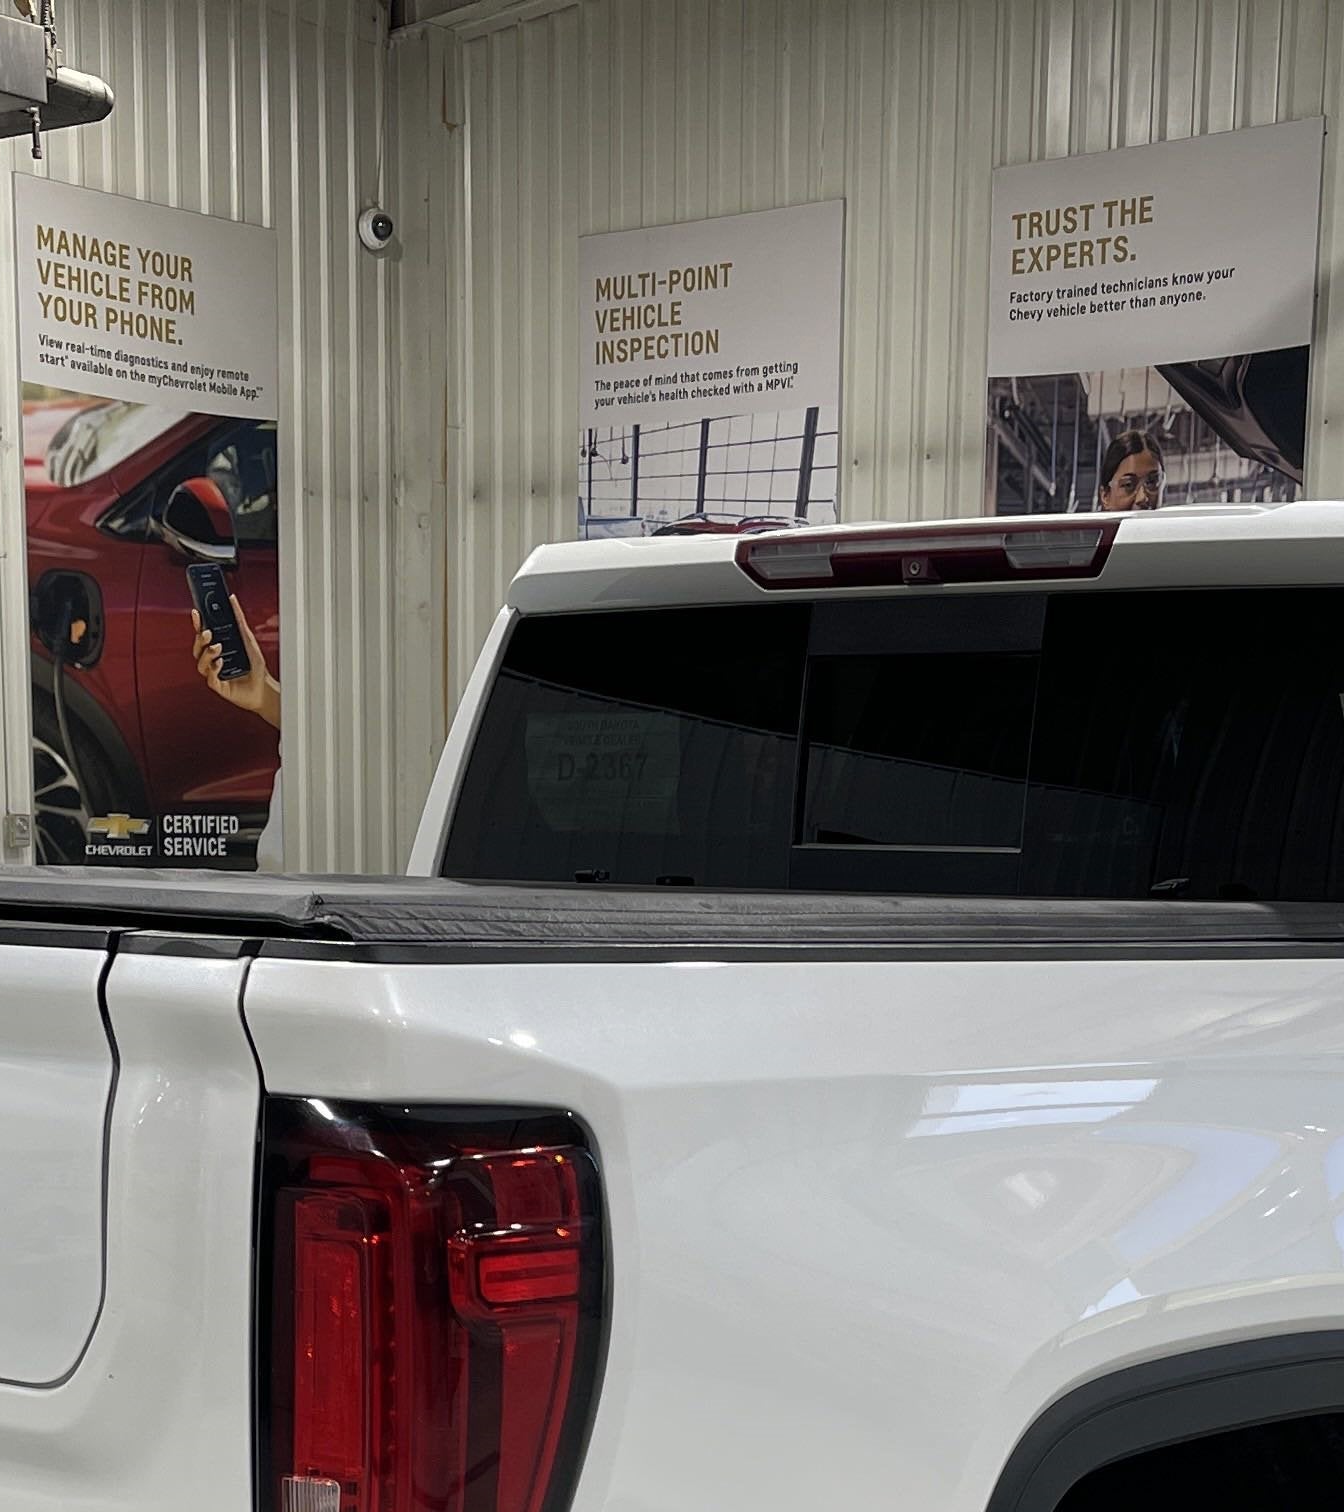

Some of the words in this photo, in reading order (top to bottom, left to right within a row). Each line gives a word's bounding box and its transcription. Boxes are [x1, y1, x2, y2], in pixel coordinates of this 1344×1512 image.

[1011, 203, 1095, 241] TRUST
[1103, 195, 1154, 229] THE
[36, 224, 130, 270] MANAGE
[137, 247, 193, 283] YOUR
[1011, 235, 1137, 275] EXPERTS.
[37, 258, 131, 304] VEHICLE
[137, 280, 195, 316] FROM
[595, 262, 733, 302] MULTI-POINT
[1009, 288, 1053, 304] Factory
[1056, 282, 1098, 300] trained
[1100, 275, 1169, 295] technicians
[1171, 272, 1204, 286] know
[1206, 267, 1236, 284] your
[37, 291, 98, 330] YOUR
[105, 306, 184, 346] PHONE.
[595, 301, 682, 334] VEHICLE
[1009, 307, 1044, 322] Chevy
[1046, 302, 1086, 318] vehicle
[1089, 298, 1126, 314] better
[1130, 294, 1156, 309] than
[1159, 290, 1206, 308] anyone.
[38, 333, 63, 350] View
[65, 341, 112, 360] real-time
[114, 349, 169, 370] diagnostics
[171, 361, 188, 373] and
[190, 364, 215, 380] enjoy
[217, 368, 249, 382] remote
[595, 329, 719, 365] INSPECTION
[70, 359, 113, 377] available
[115, 369, 128, 380] on
[130, 369, 146, 383] the
[148, 374, 207, 392] myChevrolet
[209, 381, 237, 396] Mobile
[594, 380, 611, 391] The
[613, 379, 640, 394] peace
[643, 375, 652, 386] of
[655, 373, 677, 385] mind
[680, 371, 700, 383] that
[702, 368, 733, 381] comes
[736, 365, 759, 378] from
[762, 361, 799, 379] getting
[594, 396, 615, 410] your
[617, 391, 656, 405] vehicle's
[659, 388, 688, 401] health
[690, 384, 730, 398] checked
[733, 381, 754, 394] with
[757, 382, 763, 392] a
[163, 815, 239, 834] CERTIFIED
[85, 844, 152, 856] CHEVROLET
[163, 837, 227, 856] SERVICE
